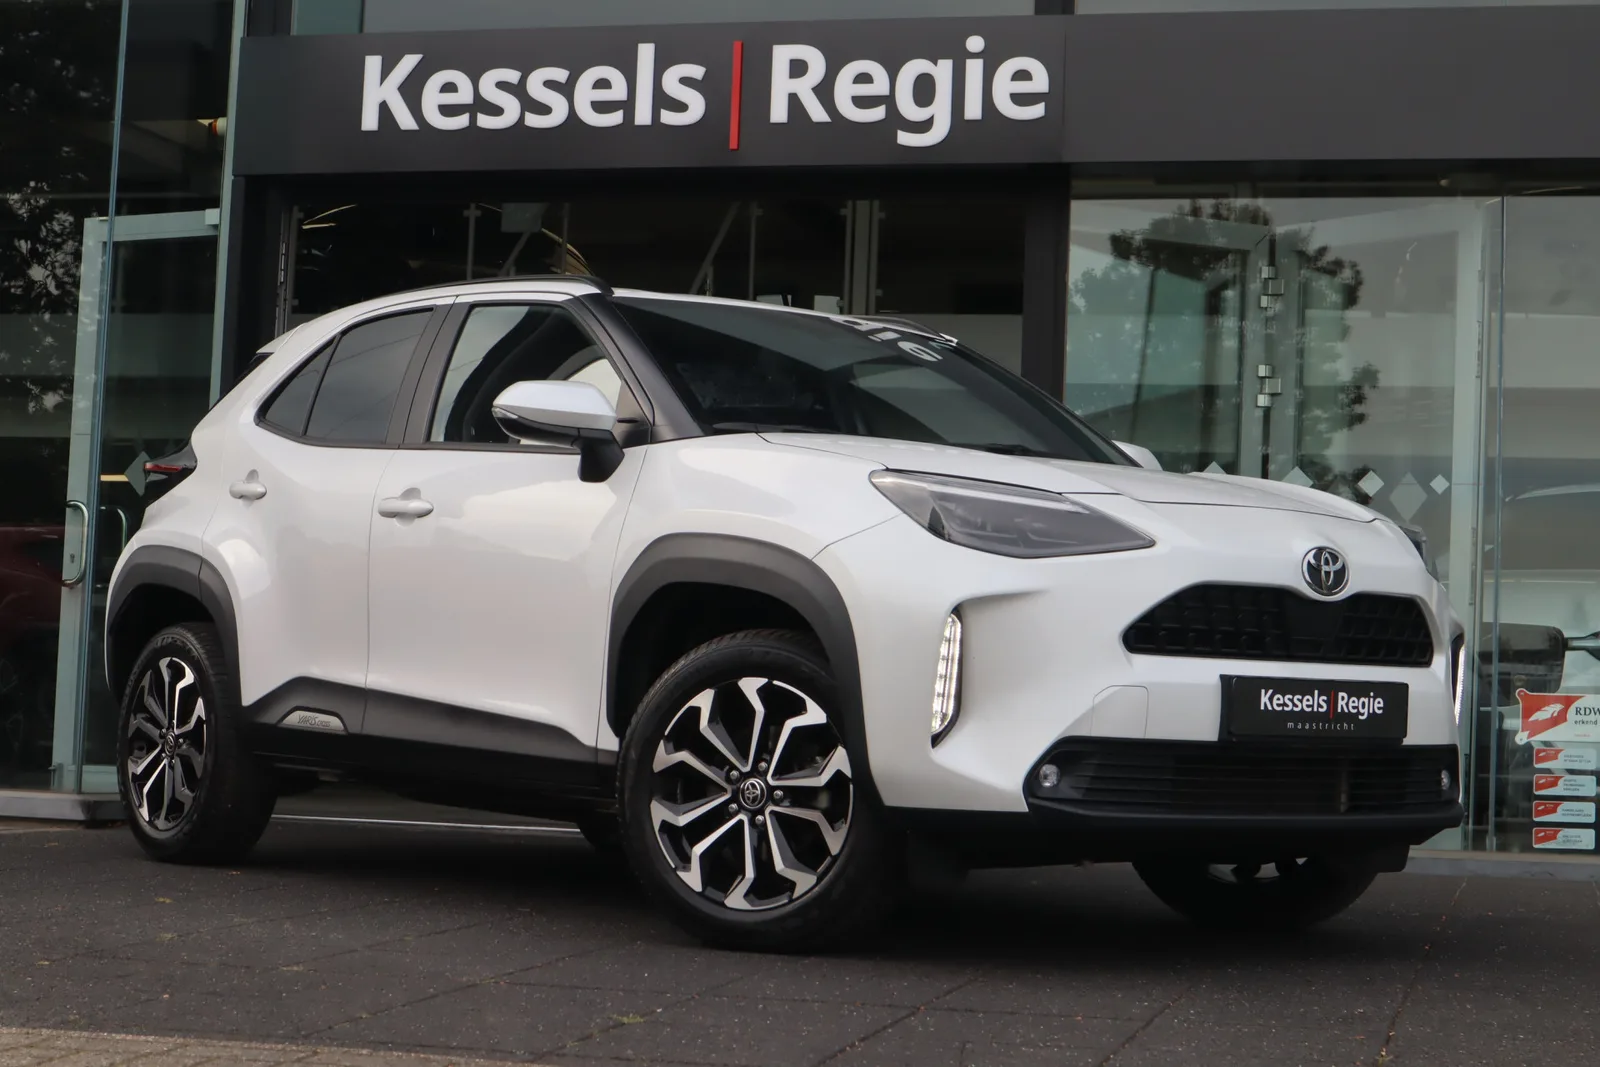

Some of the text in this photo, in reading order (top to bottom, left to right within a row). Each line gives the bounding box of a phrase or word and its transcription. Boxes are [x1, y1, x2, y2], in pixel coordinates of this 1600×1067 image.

[361, 35, 1049, 147] Kessels Regie
[1260, 688, 1384, 720] Kessels Regie
[1287, 721, 1355, 731] maastricht
[1574, 718, 1598, 726] erkend
